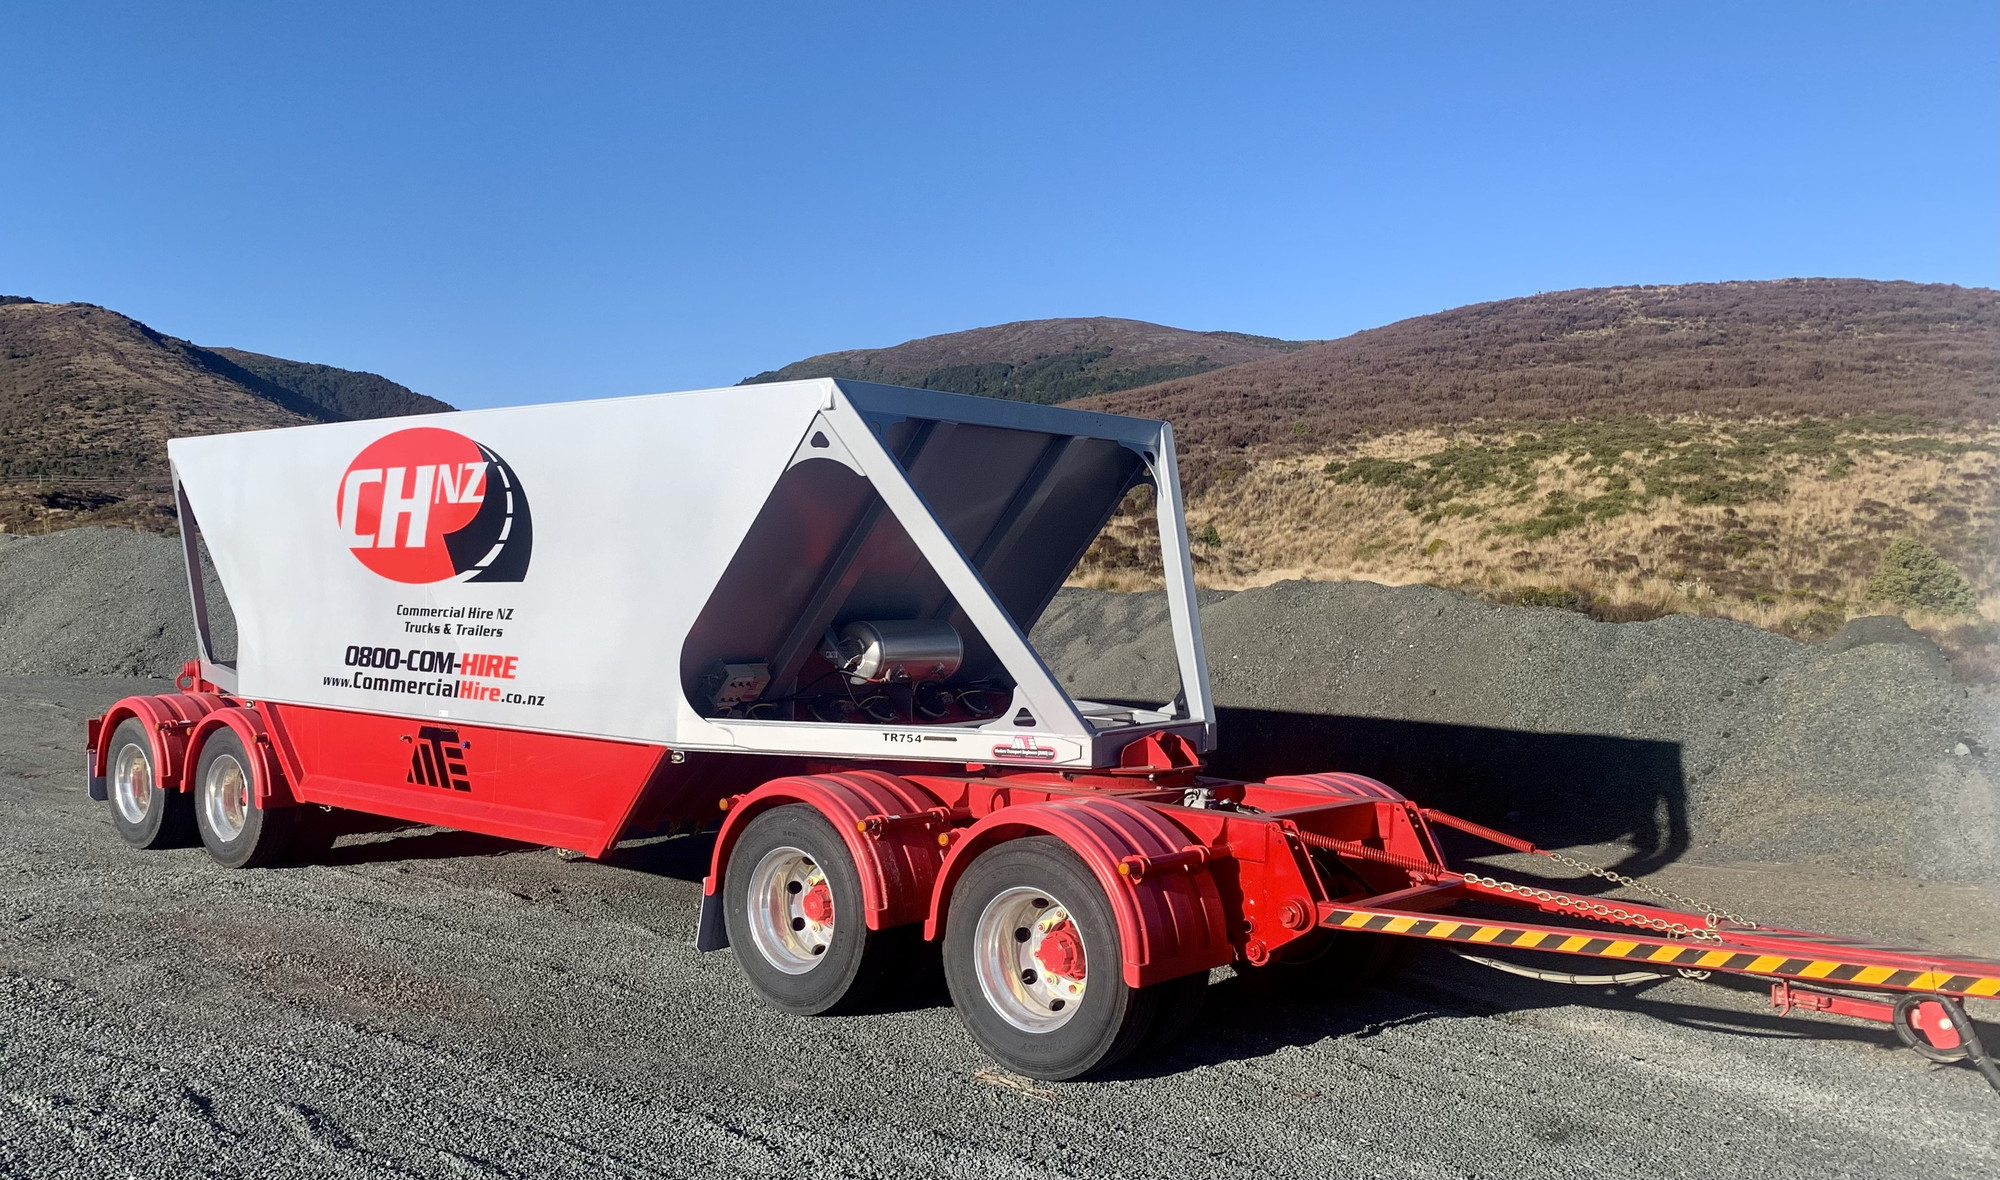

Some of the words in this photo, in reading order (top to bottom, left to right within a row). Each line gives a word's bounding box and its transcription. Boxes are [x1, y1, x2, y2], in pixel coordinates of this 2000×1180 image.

[396, 604, 465, 619] Commercial
[467, 607, 494, 620] Hire
[496, 608, 514, 621] NZ
[404, 621, 441, 635] Trucks
[443, 623, 452, 635] &
[456, 623, 503, 638] Trailers
[344, 645, 519, 680] 0800-COM-HIRE
[322, 672, 545, 706] www.CommercialHire.co.nz
[882, 732, 922, 743] TR754
